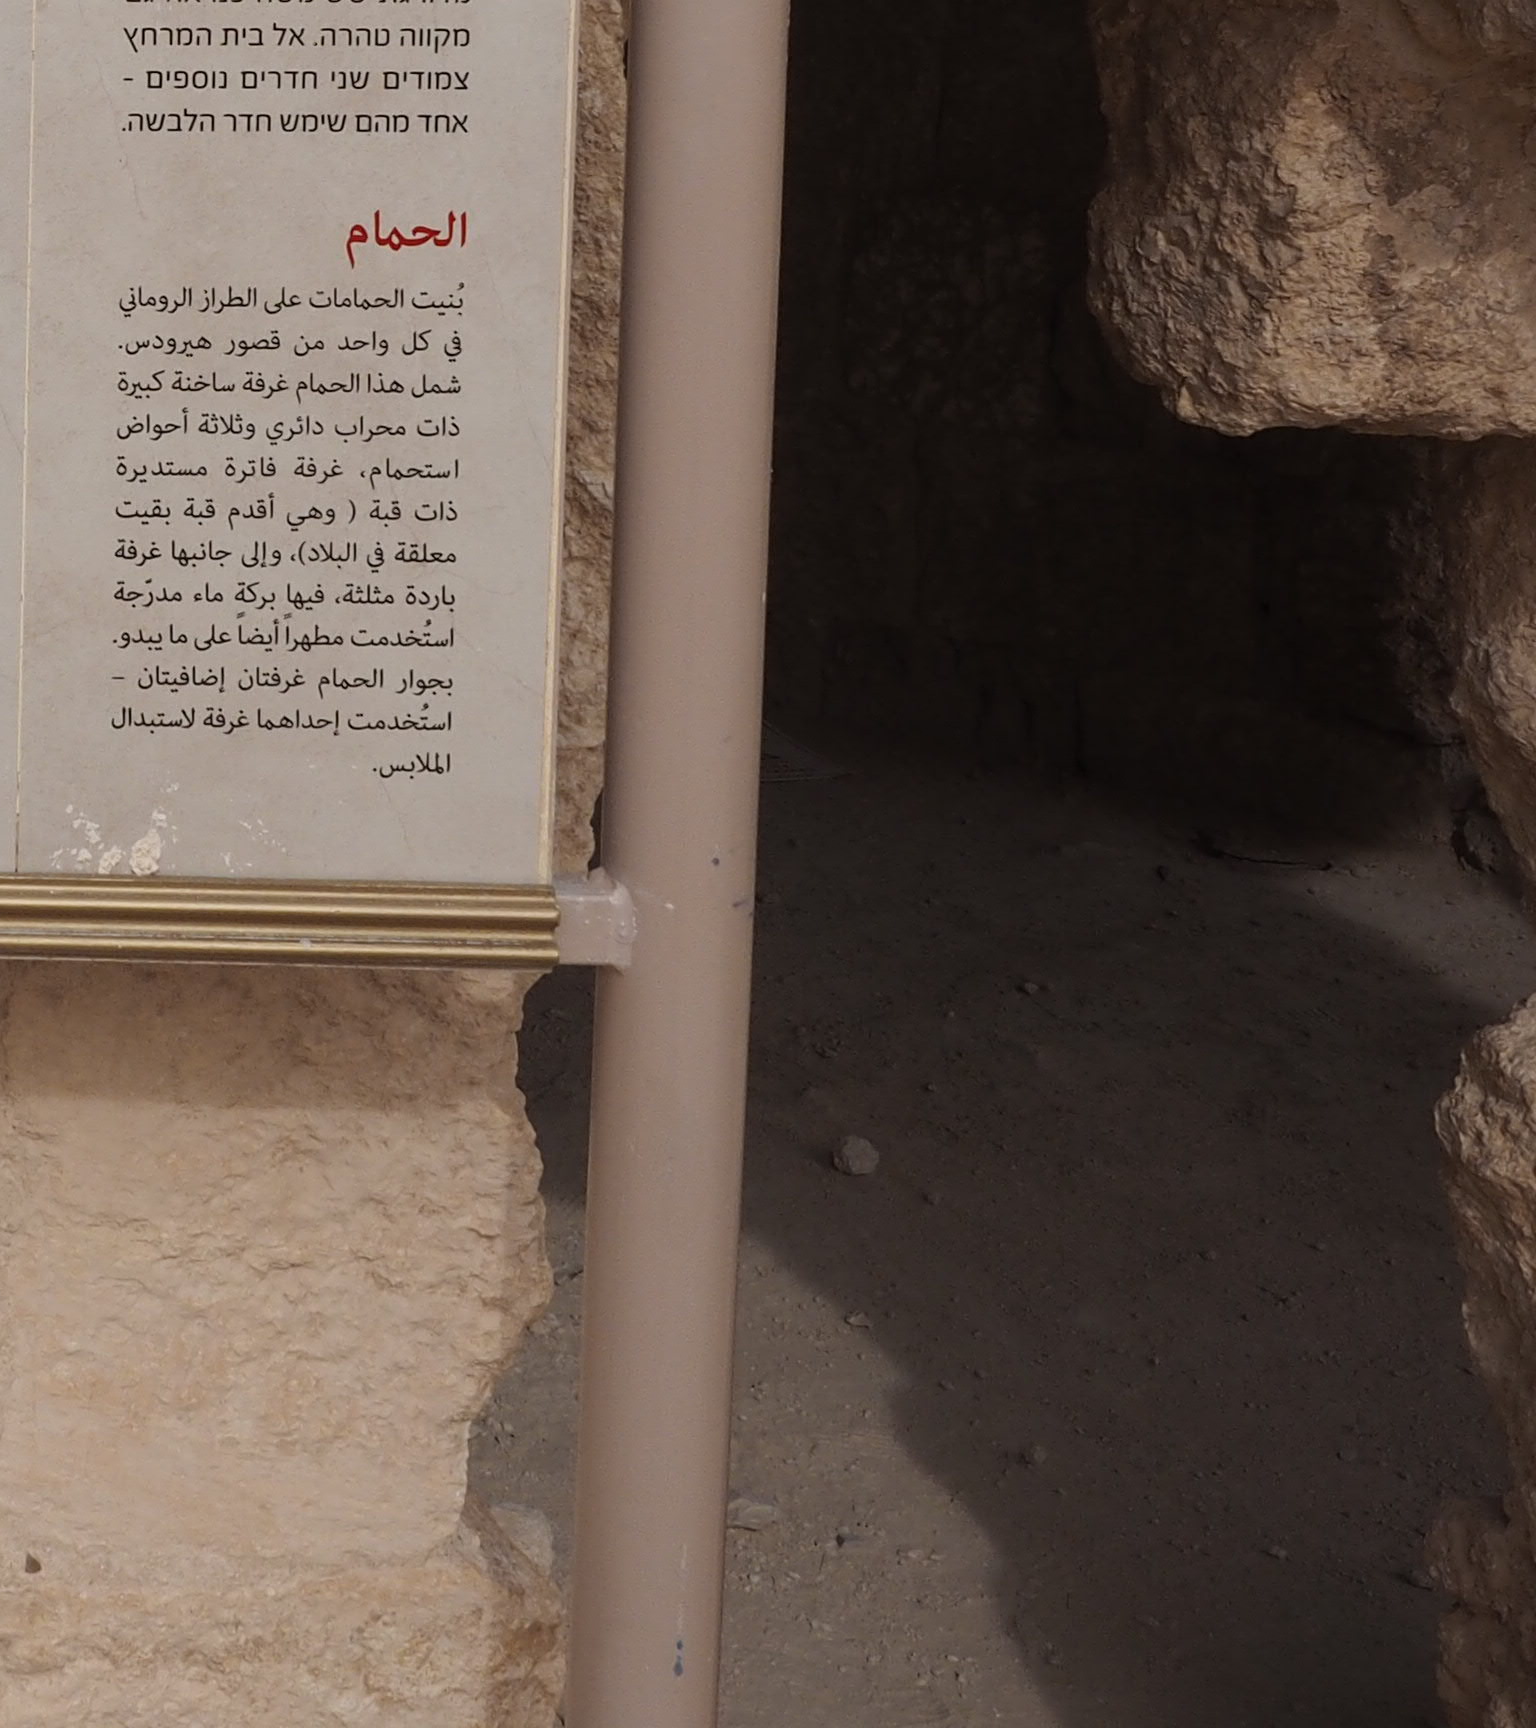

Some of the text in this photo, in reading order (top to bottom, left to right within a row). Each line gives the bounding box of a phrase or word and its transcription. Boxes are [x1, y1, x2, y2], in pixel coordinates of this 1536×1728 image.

[346, 209, 467, 269] الحمام
[118, 329, 462, 363] في كل واحد من قصور هيرودس.
[117, 407, 460, 446] ذات محراب دائري وثلاثة أحواض
